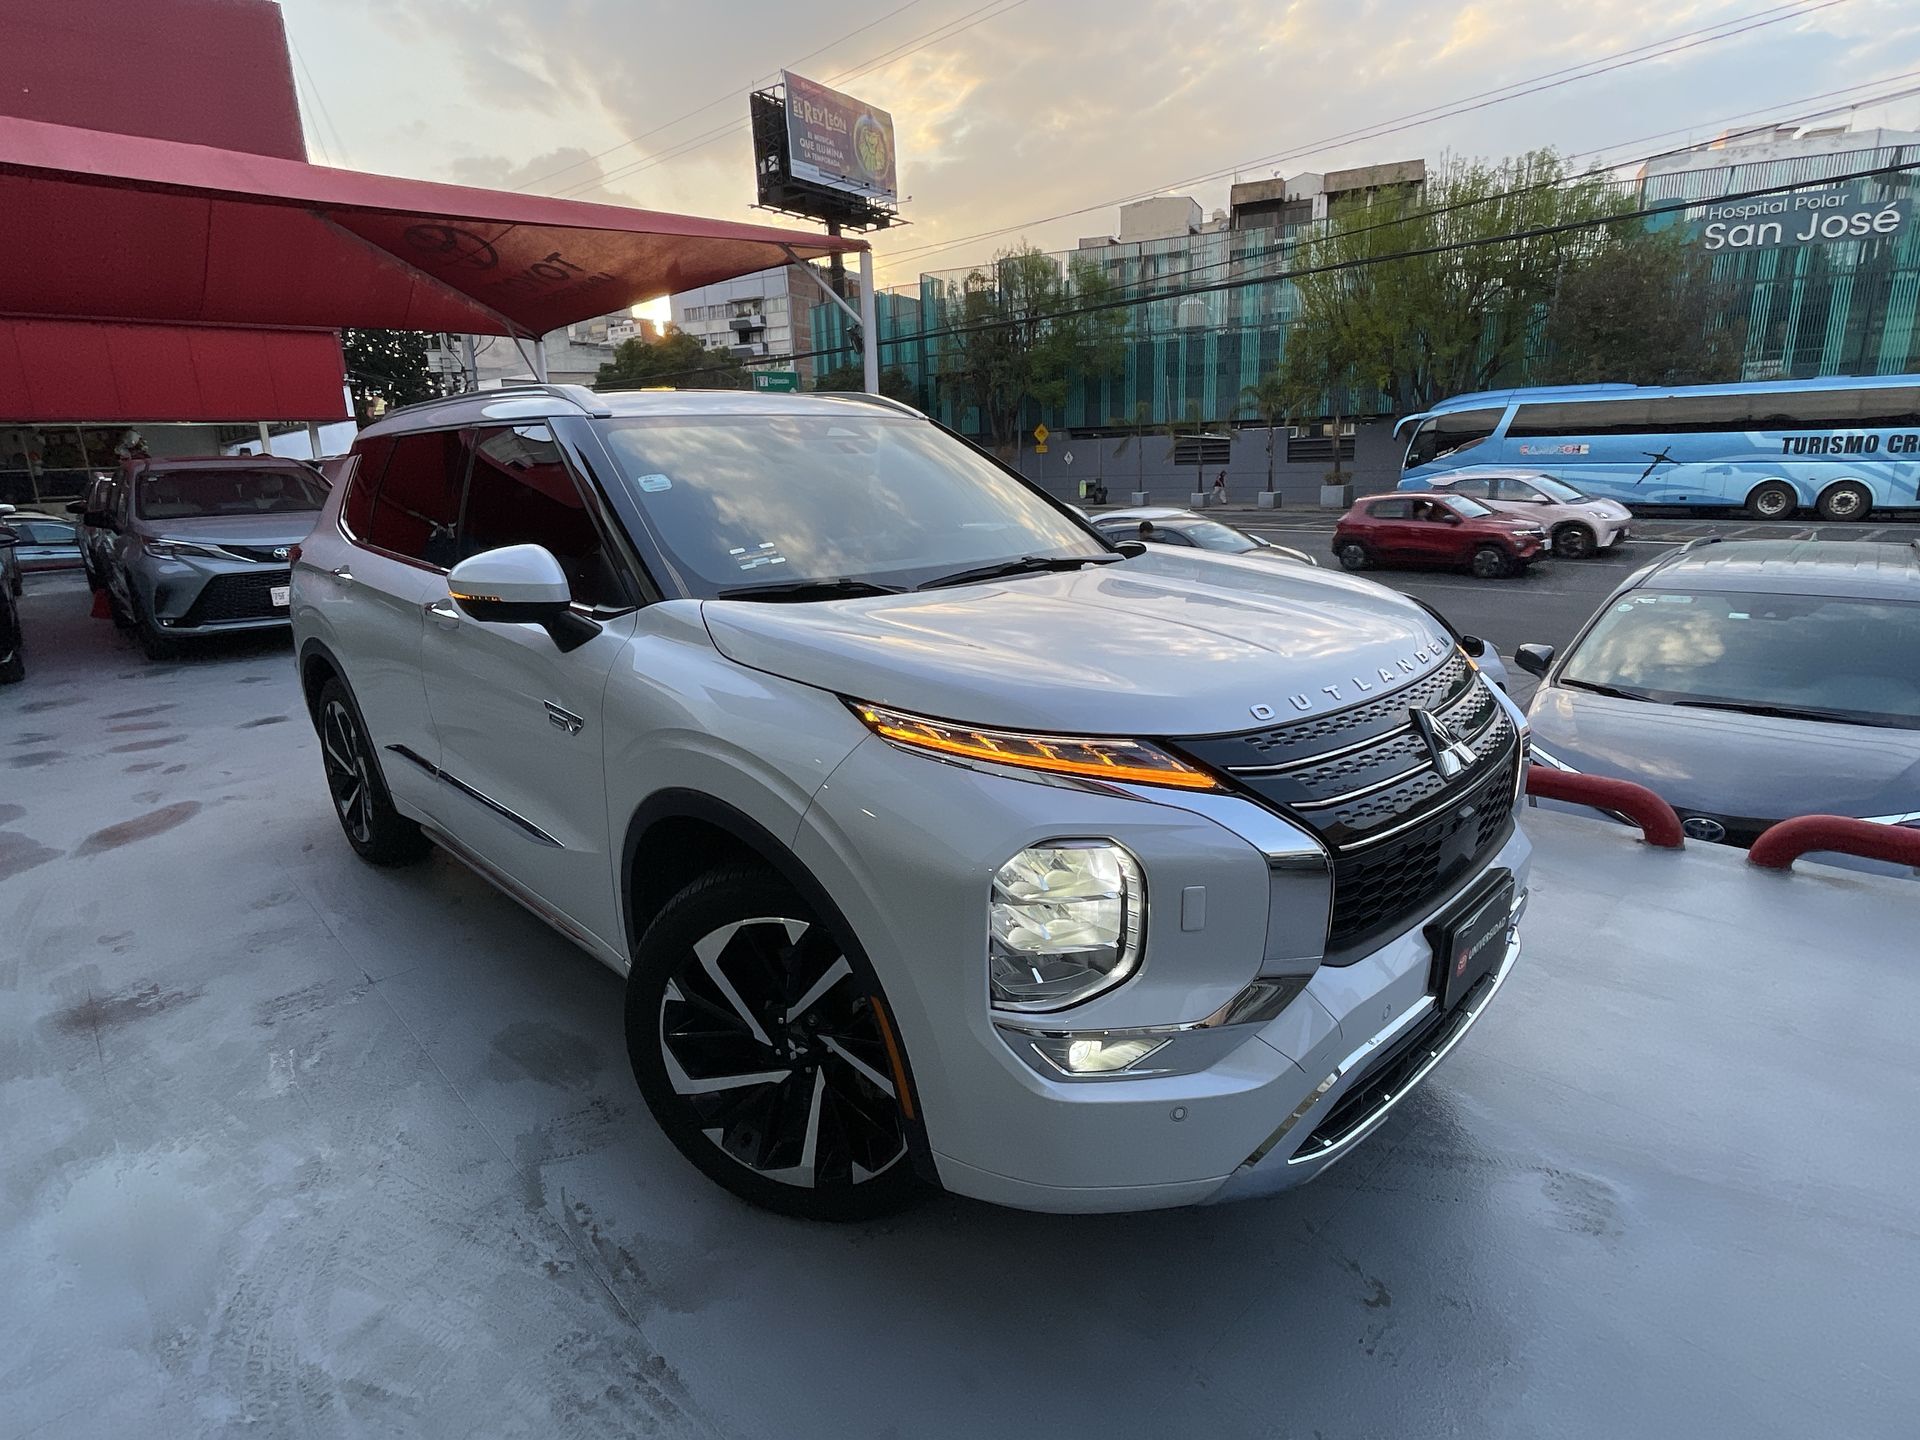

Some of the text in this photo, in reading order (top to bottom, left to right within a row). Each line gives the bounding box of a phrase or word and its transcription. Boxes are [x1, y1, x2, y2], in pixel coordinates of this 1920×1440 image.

[793, 99, 804, 115] EL
[804, 101, 824, 125] REY
[800, 137, 844, 160] QUE ILUMINA
[1709, 194, 1850, 221] Hospital Polar
[1704, 201, 1901, 250] San José
[1782, 434, 1920, 455] TURISMO CR
[1250, 636, 1451, 721] OUTLANDER
